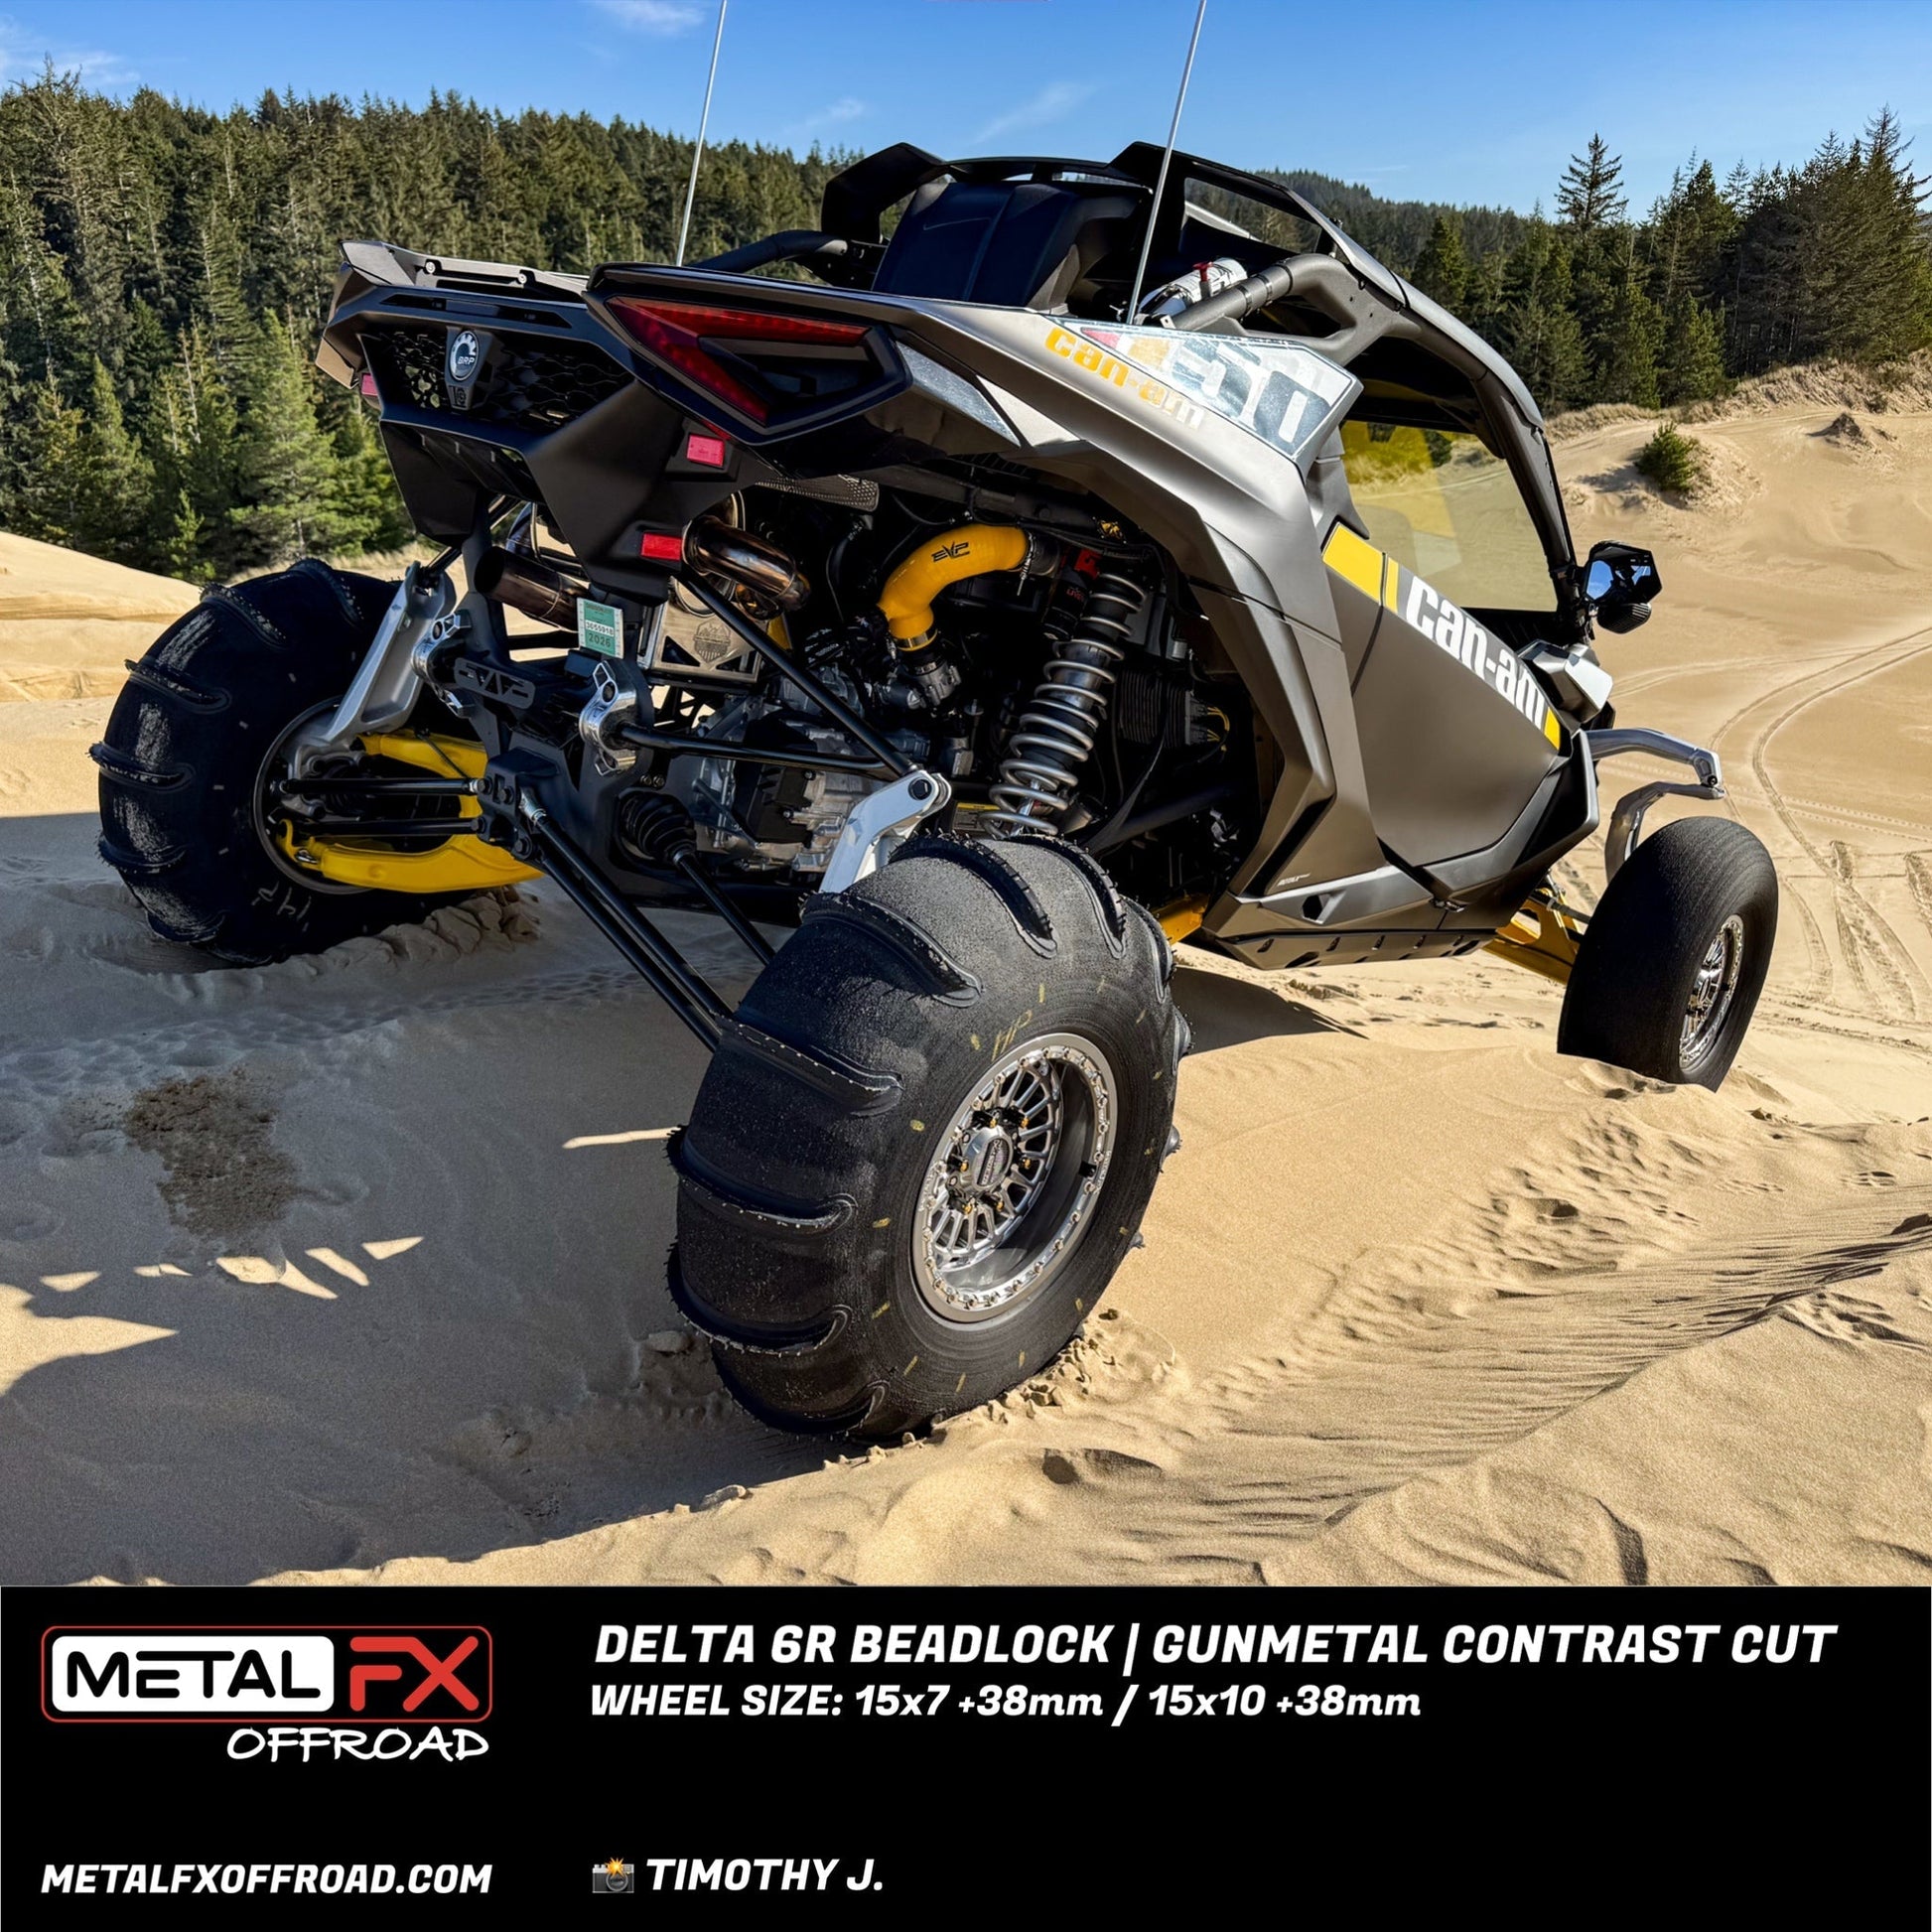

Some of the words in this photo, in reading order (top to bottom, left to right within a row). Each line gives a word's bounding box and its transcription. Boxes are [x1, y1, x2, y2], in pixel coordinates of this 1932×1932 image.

[458, 355, 476, 365] BRP
[1045, 327, 1204, 430] can-am
[588, 632, 612, 647] 2026
[1406, 575, 1545, 730] can-am
